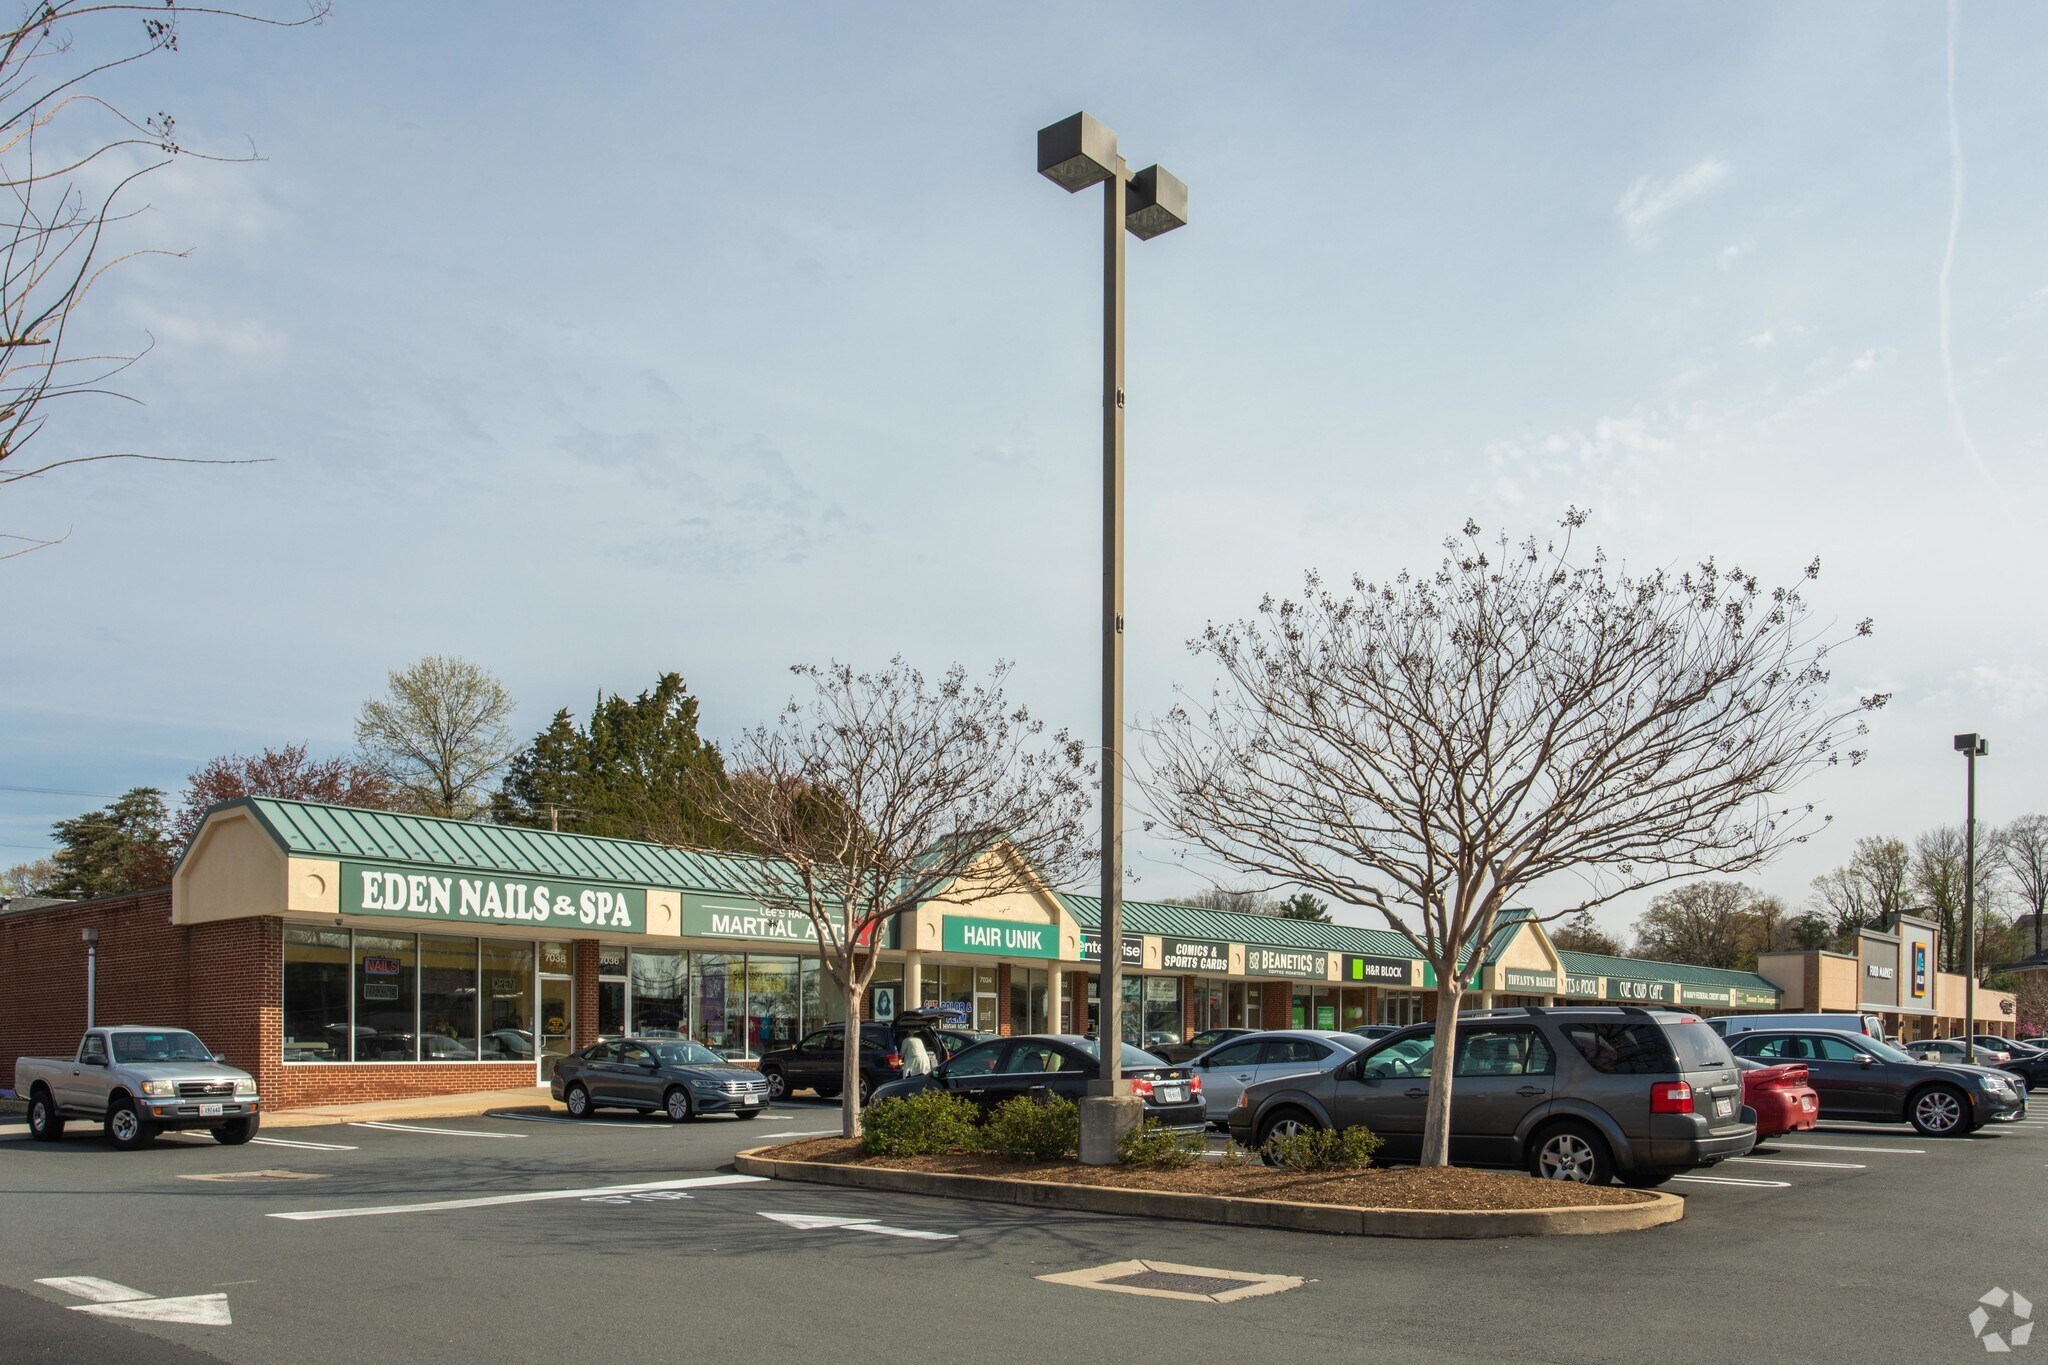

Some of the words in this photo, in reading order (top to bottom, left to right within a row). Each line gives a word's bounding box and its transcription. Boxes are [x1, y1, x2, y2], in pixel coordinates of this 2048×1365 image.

[361, 871, 452, 915] EDEN
[459, 878, 550, 922] NAILS
[553, 895, 577, 916] &
[579, 889, 632, 927] SPA
[760, 907, 785, 918] LEE'S
[712, 914, 798, 938] MARTIAL
[964, 925, 1001, 947] HAIR
[1006, 929, 1042, 950] UNIK
[1079, 940, 1141, 957] enteise
[1176, 943, 1208, 957] COMICS
[1211, 946, 1217, 958] &
[545, 953, 566, 963] 7038
[600, 956, 620, 965] 7036
[1164, 955, 1198, 969] SPORTS
[1200, 957, 1228, 971] CARDS
[1262, 950, 1313, 972] BEANETICS
[366, 960, 398, 973] NAILS
[1365, 964, 1380, 976] H&R
[1381, 965, 1402, 978] BLOCK
[1869, 966, 1879, 977] FOOD
[1879, 967, 1893, 980] MARKET
[492, 977, 515, 990] OPEN
[979, 976, 992, 984] 7034
[1507, 974, 1535, 987] TIFFANY'S
[1535, 975, 1557, 988] BAKERY
[1575, 980, 1580, 991] &
[1580, 979, 1597, 995] POOL
[1619, 981, 1632, 998] CUE
[1649, 984, 1664, 1000] CAFE
[966, 1003, 972, 1013] &
